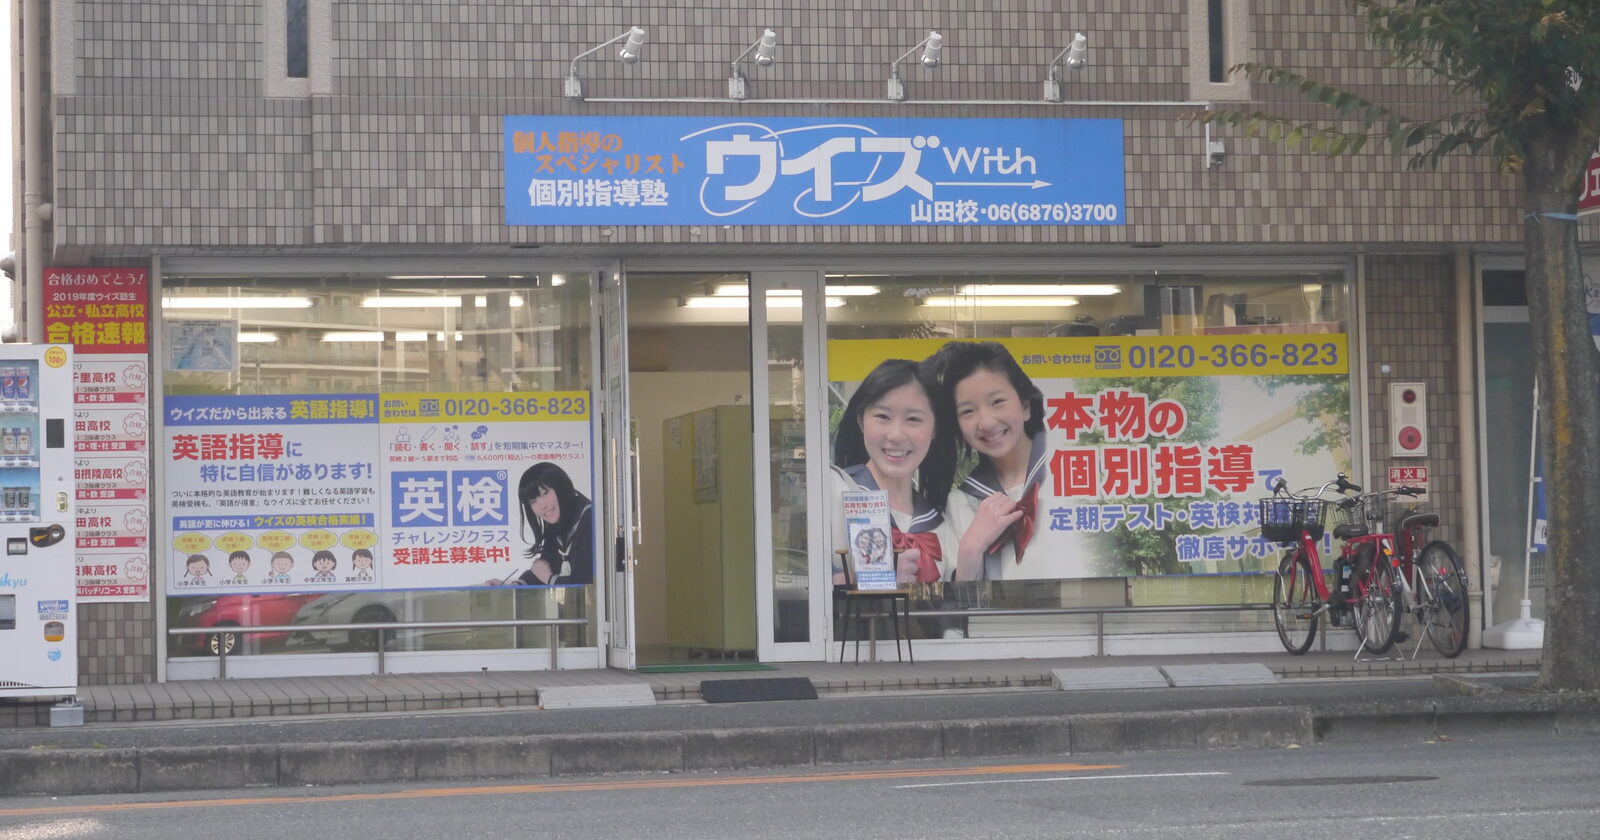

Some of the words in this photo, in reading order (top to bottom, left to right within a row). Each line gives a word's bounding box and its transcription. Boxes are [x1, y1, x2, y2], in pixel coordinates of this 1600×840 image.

[512, 131, 623, 154] 個人指導の
[535, 153, 685, 175] スペシャリスト
[706, 134, 940, 201] ウイズ
[942, 147, 1037, 175] With
[528, 179, 669, 207] 個別指導塾
[911, 200, 1117, 223] 山田校・06(6876)3700
[48, 273, 144, 286] 合格おめでとう!
[47, 304, 144, 318] 公立・私立高校
[47, 321, 146, 345] 合格速報
[1021, 354, 1092, 365] お問い合わせは
[1128, 343, 1338, 369] 0120-366-823
[170, 406, 287, 420] ウイズだから出来る
[290, 400, 374, 420] 英語指導!
[444, 398, 586, 416] 0120-366-823
[1046, 391, 1185, 440] 本物の
[172, 432, 303, 461] 英語指導に
[200, 462, 372, 482] 特に自信があります!
[1049, 445, 1283, 497] 個別指導で
[1391, 468, 1426, 479] 消火器
[391, 530, 510, 546] チャレンジクラス
[393, 546, 510, 565] 受講生募集中!
